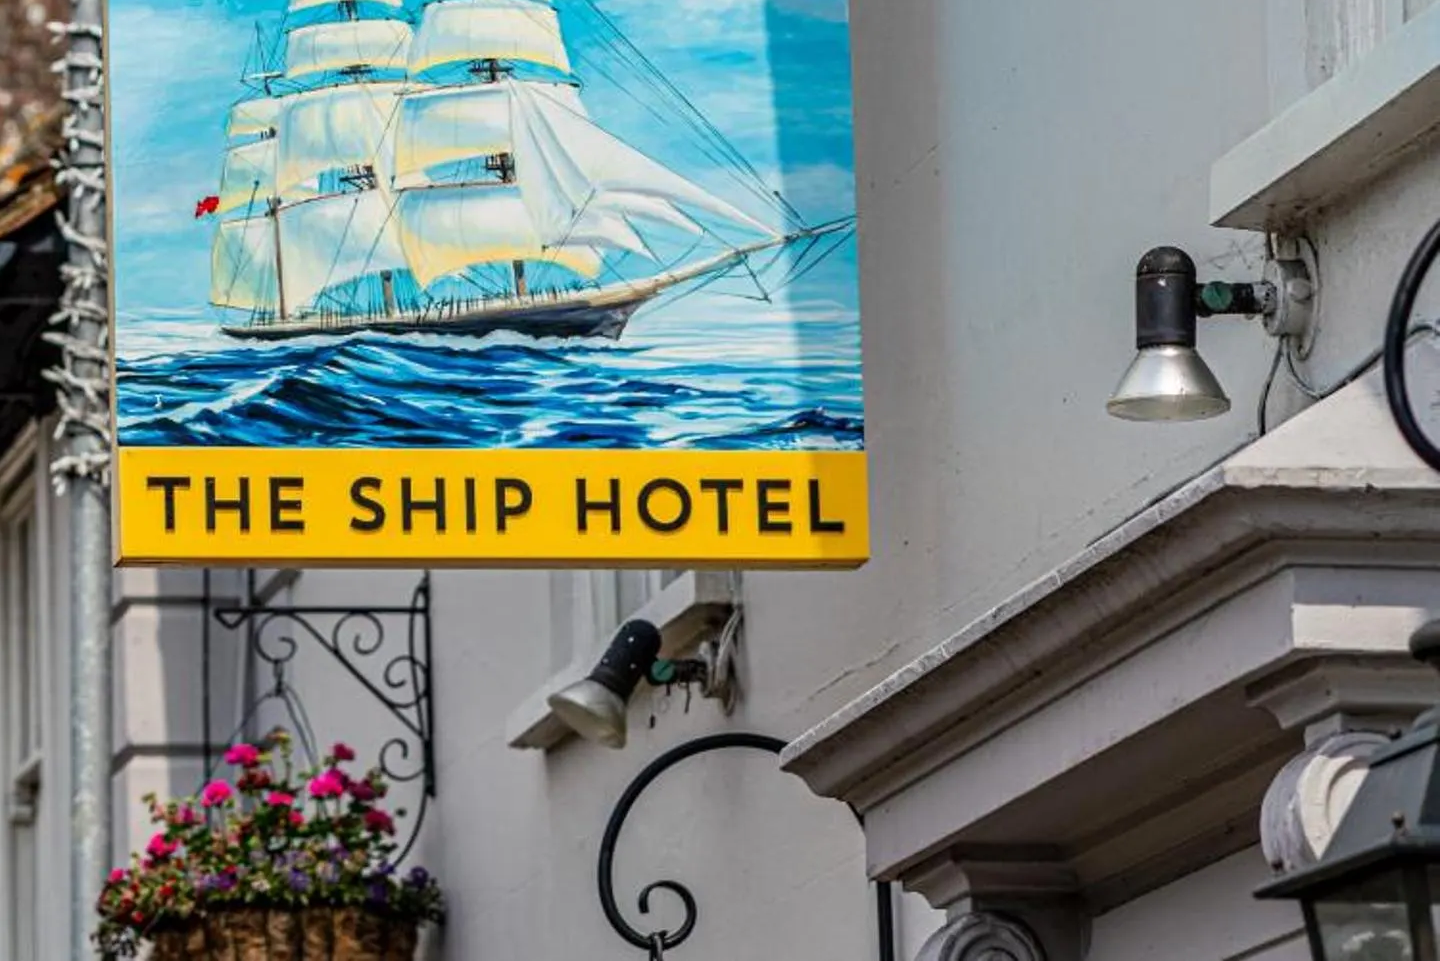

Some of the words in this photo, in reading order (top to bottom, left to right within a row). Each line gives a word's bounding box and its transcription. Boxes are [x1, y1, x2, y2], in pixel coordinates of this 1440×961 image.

[146, 476, 306, 533] THE
[349, 476, 534, 533] SHIP
[575, 477, 846, 534] HOTEL
